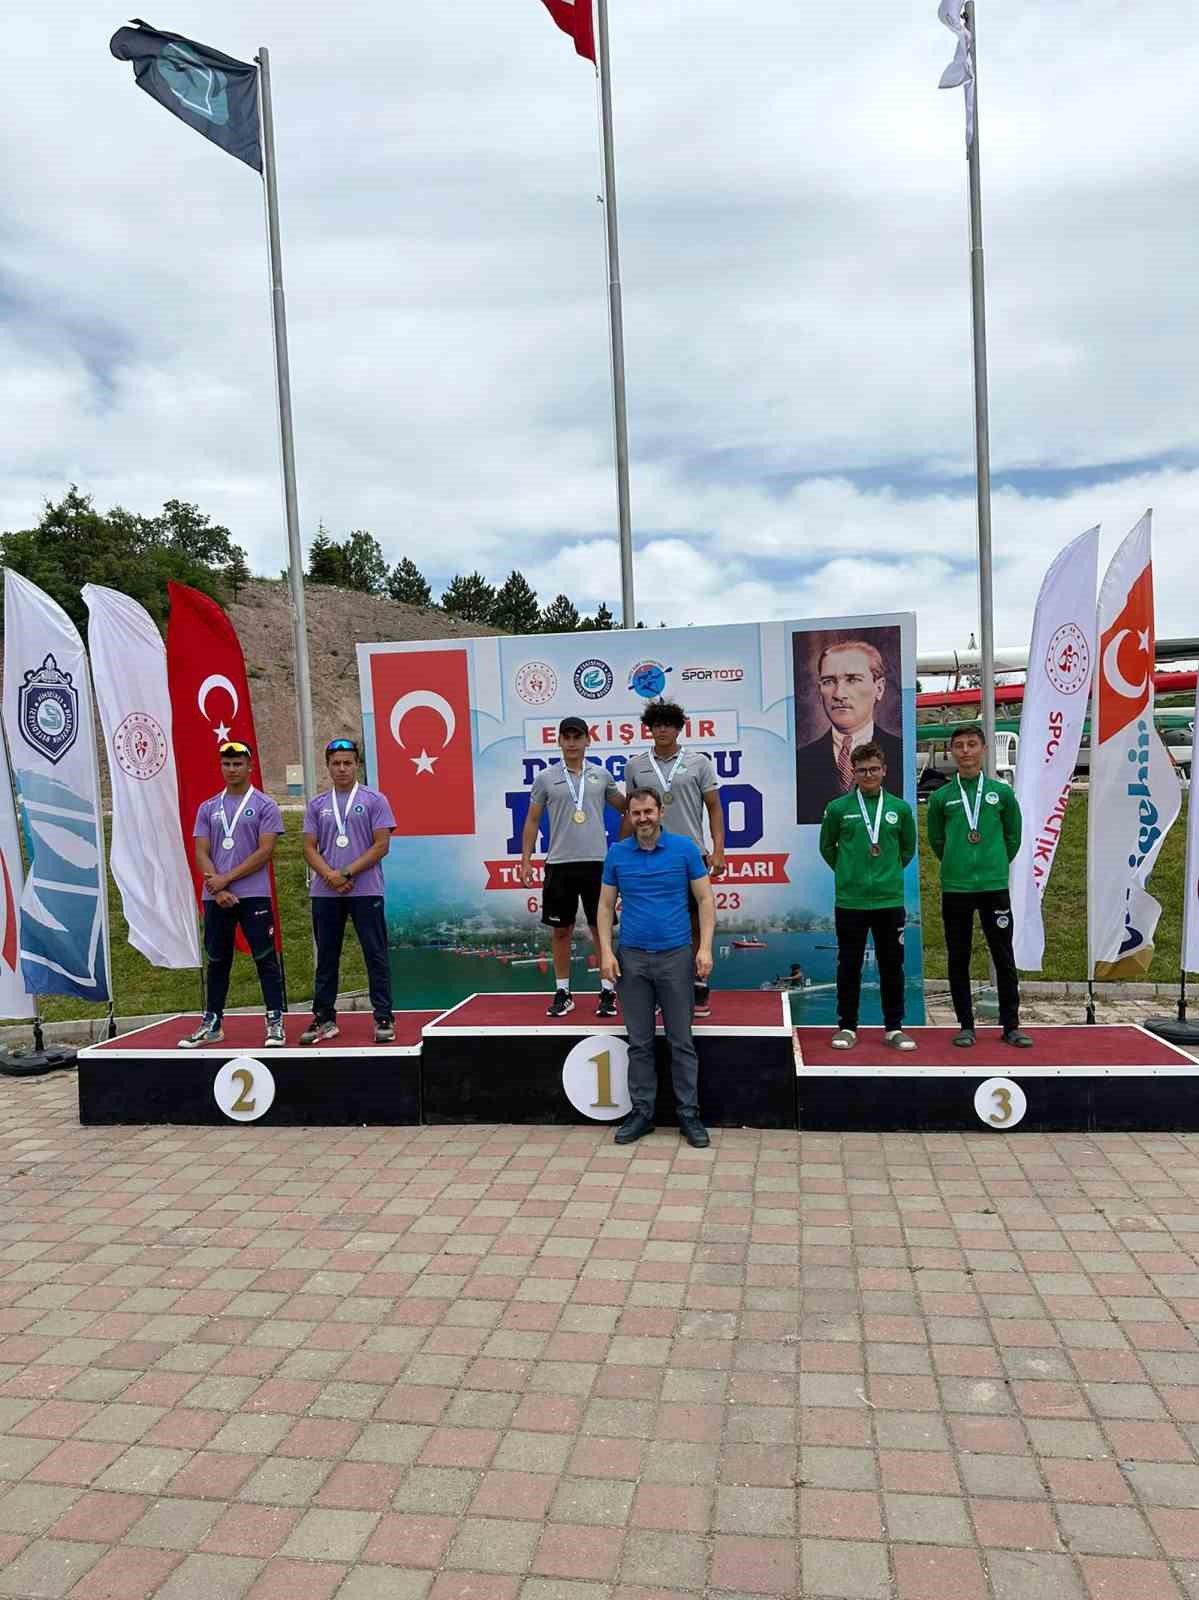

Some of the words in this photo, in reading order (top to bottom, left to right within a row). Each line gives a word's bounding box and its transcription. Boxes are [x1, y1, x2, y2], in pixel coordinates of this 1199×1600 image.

[681, 669, 744, 681] SPORTOTO
[543, 716, 716, 745] EKİŞEİR
[1045, 712, 1063, 763] SPO
[716, 893, 741, 910] 23
[231, 1069, 256, 1111] 2
[588, 1050, 619, 1108] 1
[990, 1087, 1012, 1123] 3
